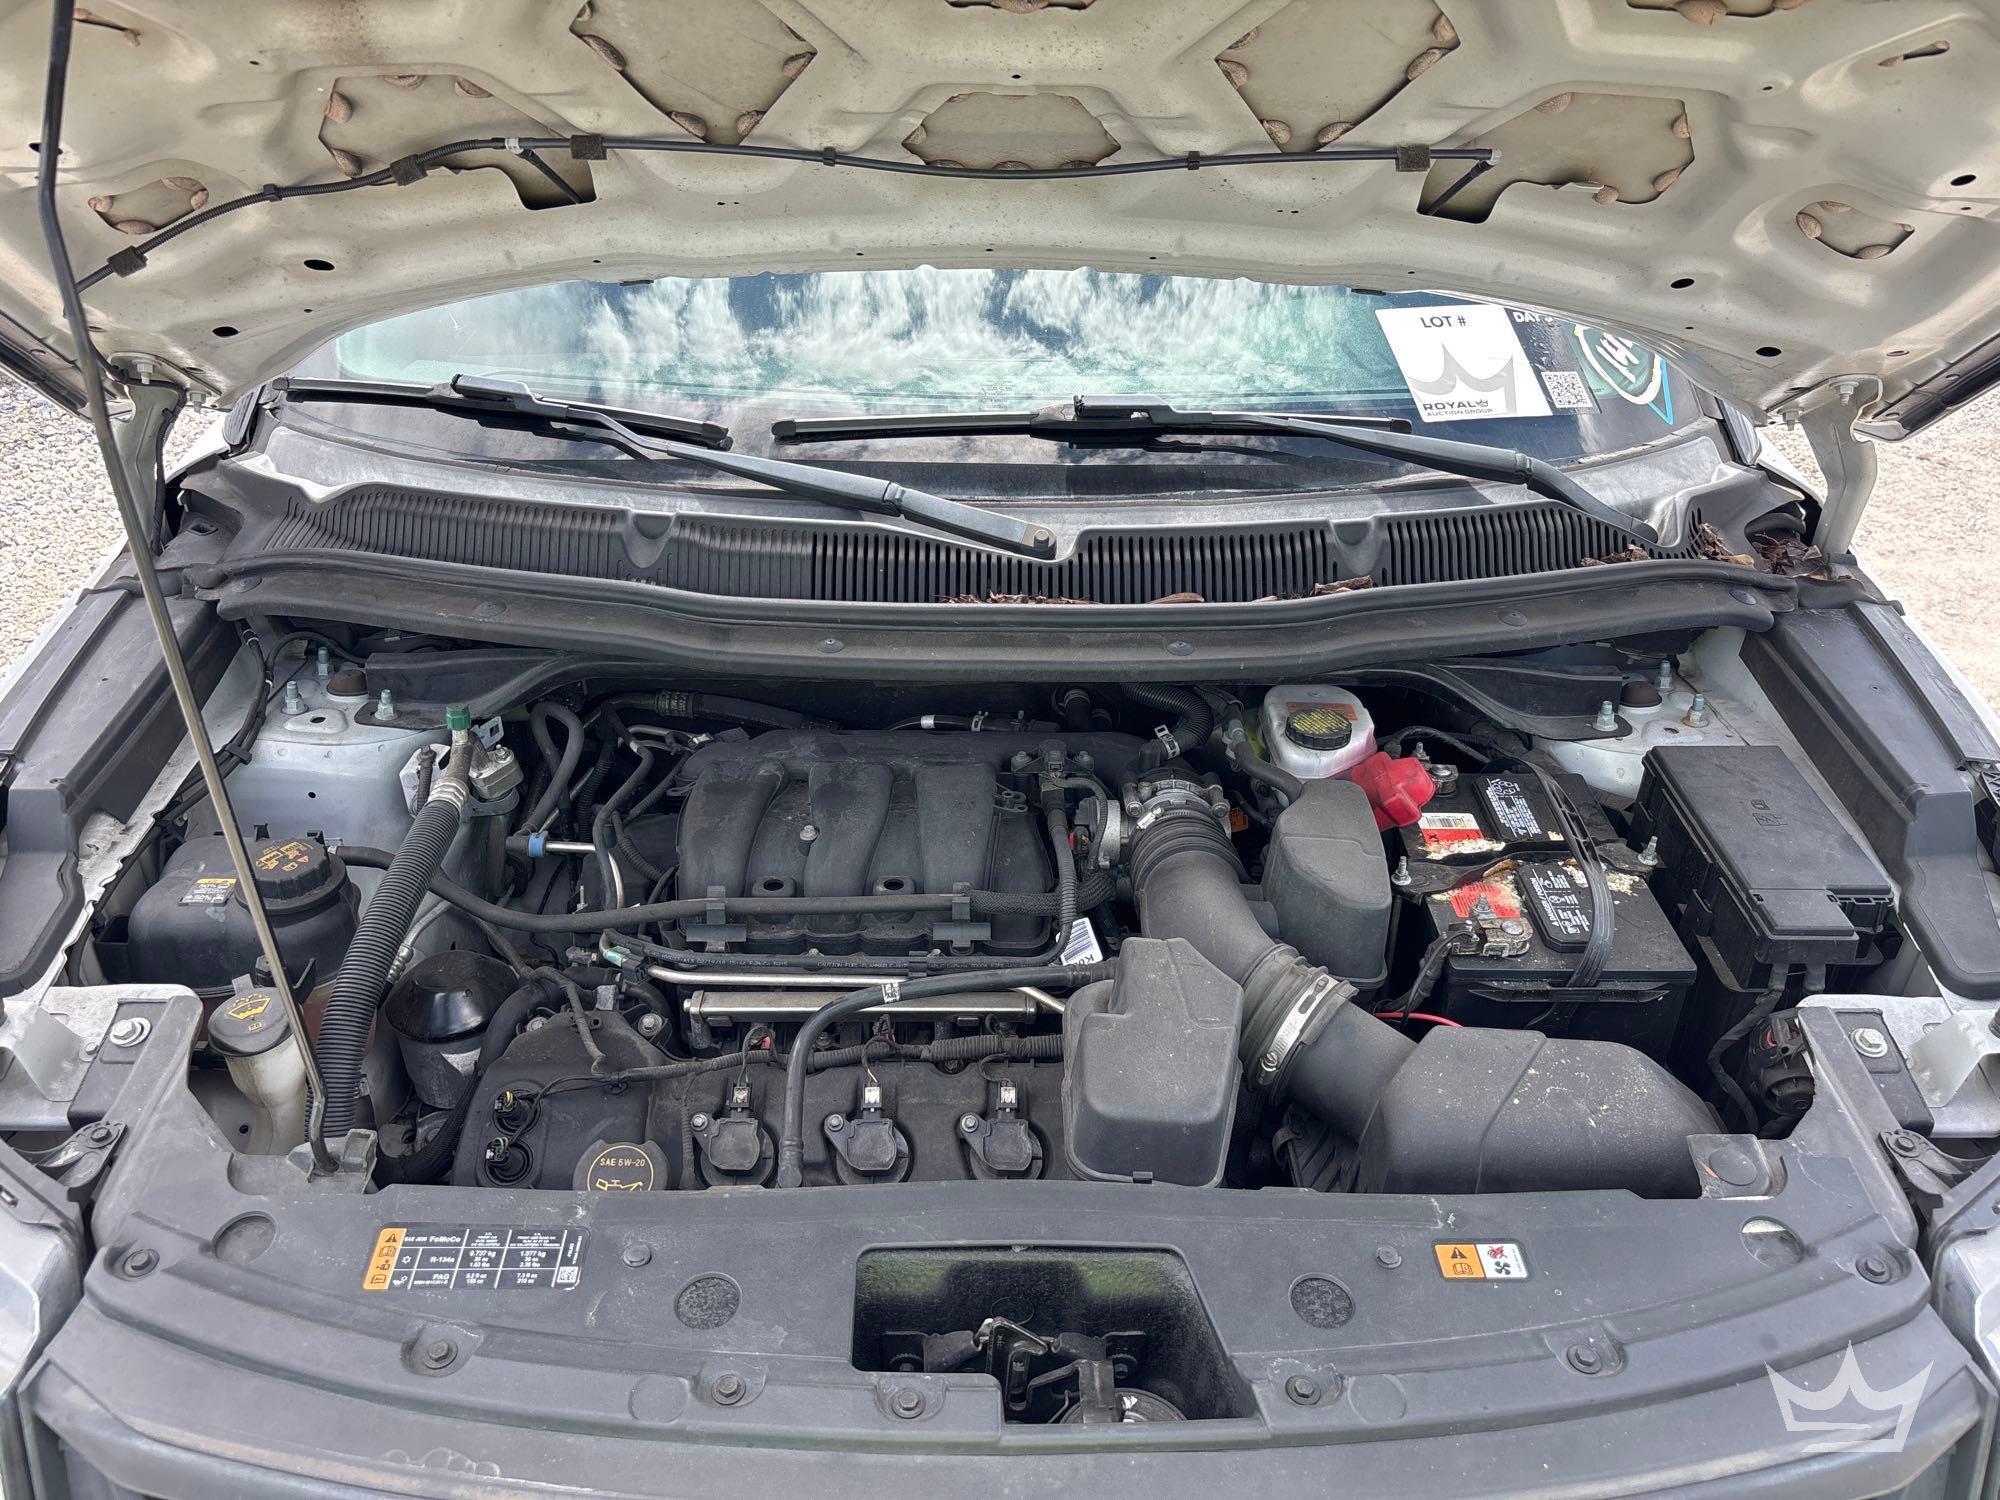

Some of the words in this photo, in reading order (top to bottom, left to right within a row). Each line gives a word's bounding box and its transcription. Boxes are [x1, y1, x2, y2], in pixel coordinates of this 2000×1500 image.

[1420, 315, 1452, 328] LOT
[1457, 315, 1467, 327] #
[1423, 400, 1477, 411] ROYAL
[600, 1158, 616, 1167] SAE
[618, 1158, 646, 1167] 5W-20
